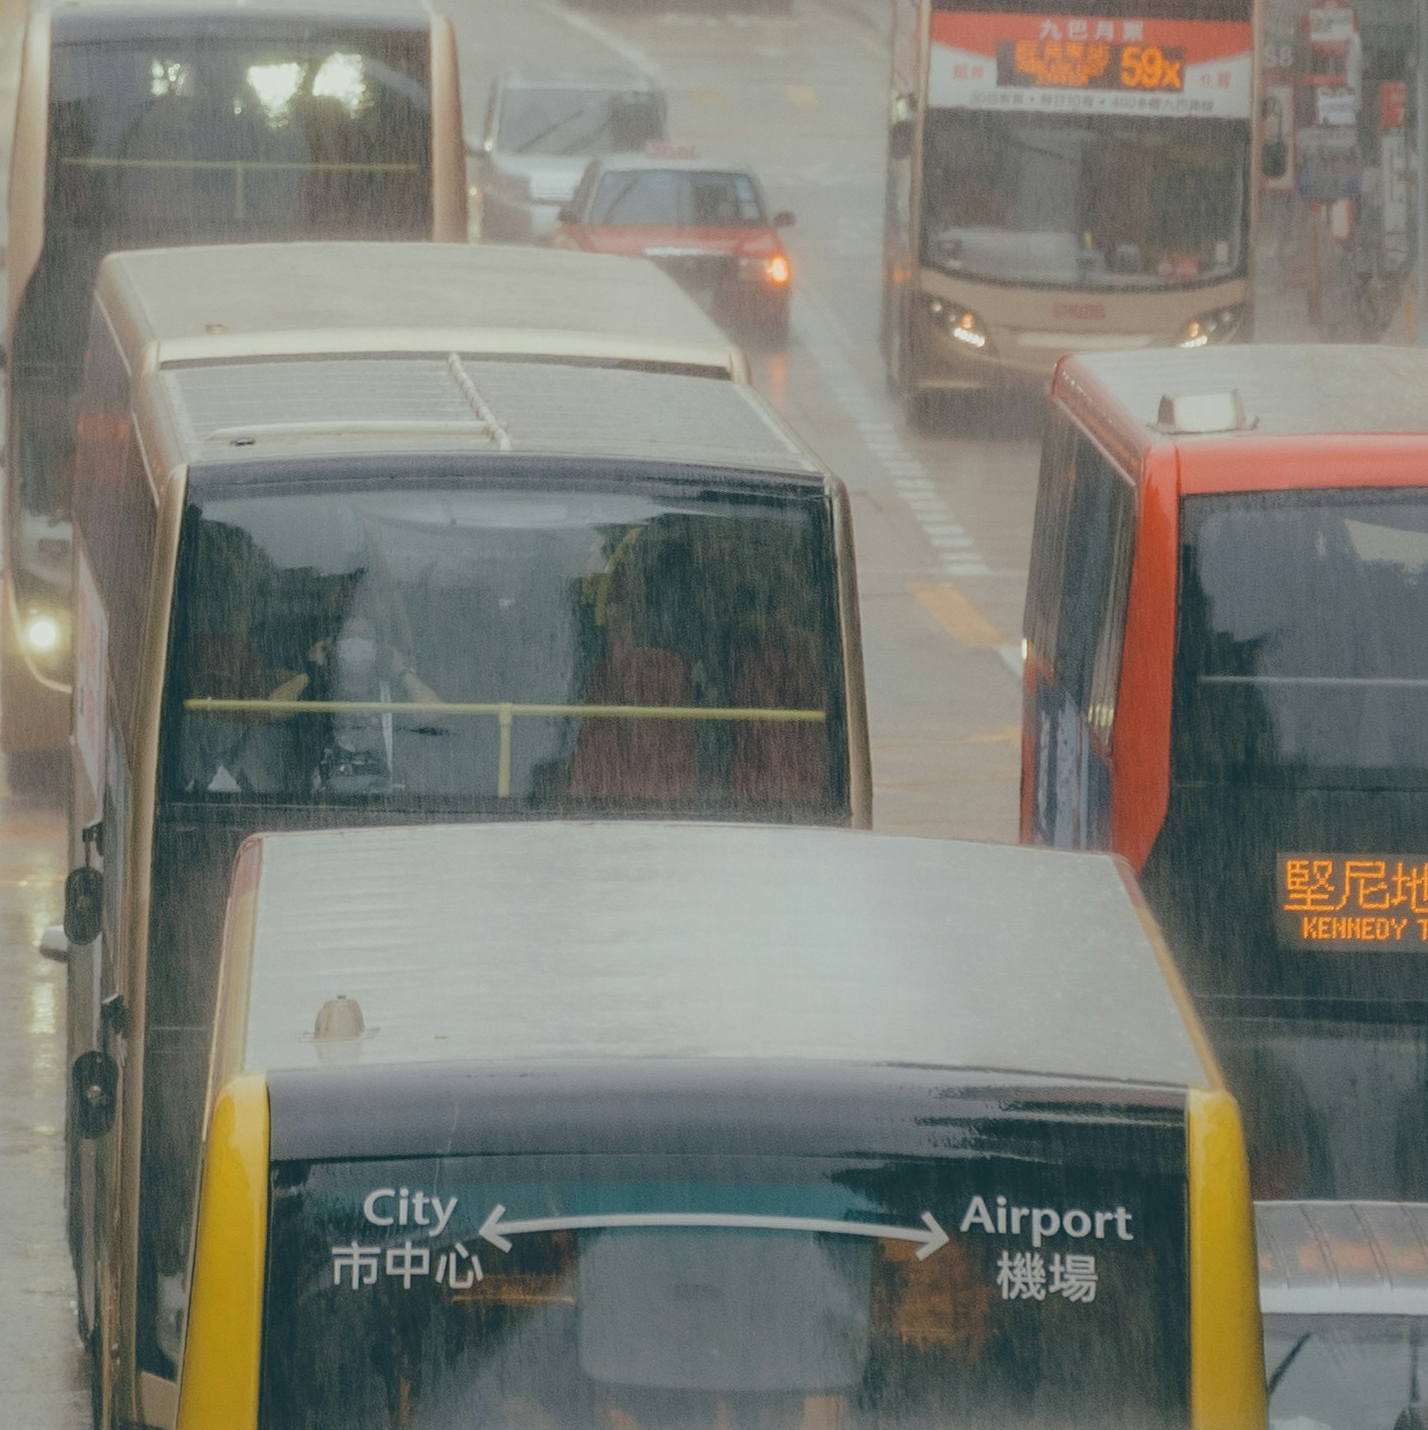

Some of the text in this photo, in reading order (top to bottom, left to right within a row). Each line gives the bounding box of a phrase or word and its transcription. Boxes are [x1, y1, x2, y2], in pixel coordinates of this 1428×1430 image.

[1302, 916, 1409, 941] KENNEDY
[362, 1186, 459, 1239] City
[959, 1194, 1134, 1244] Airport
[330, 1241, 484, 1293] 市中心
[994, 1249, 1100, 1306] 機場
